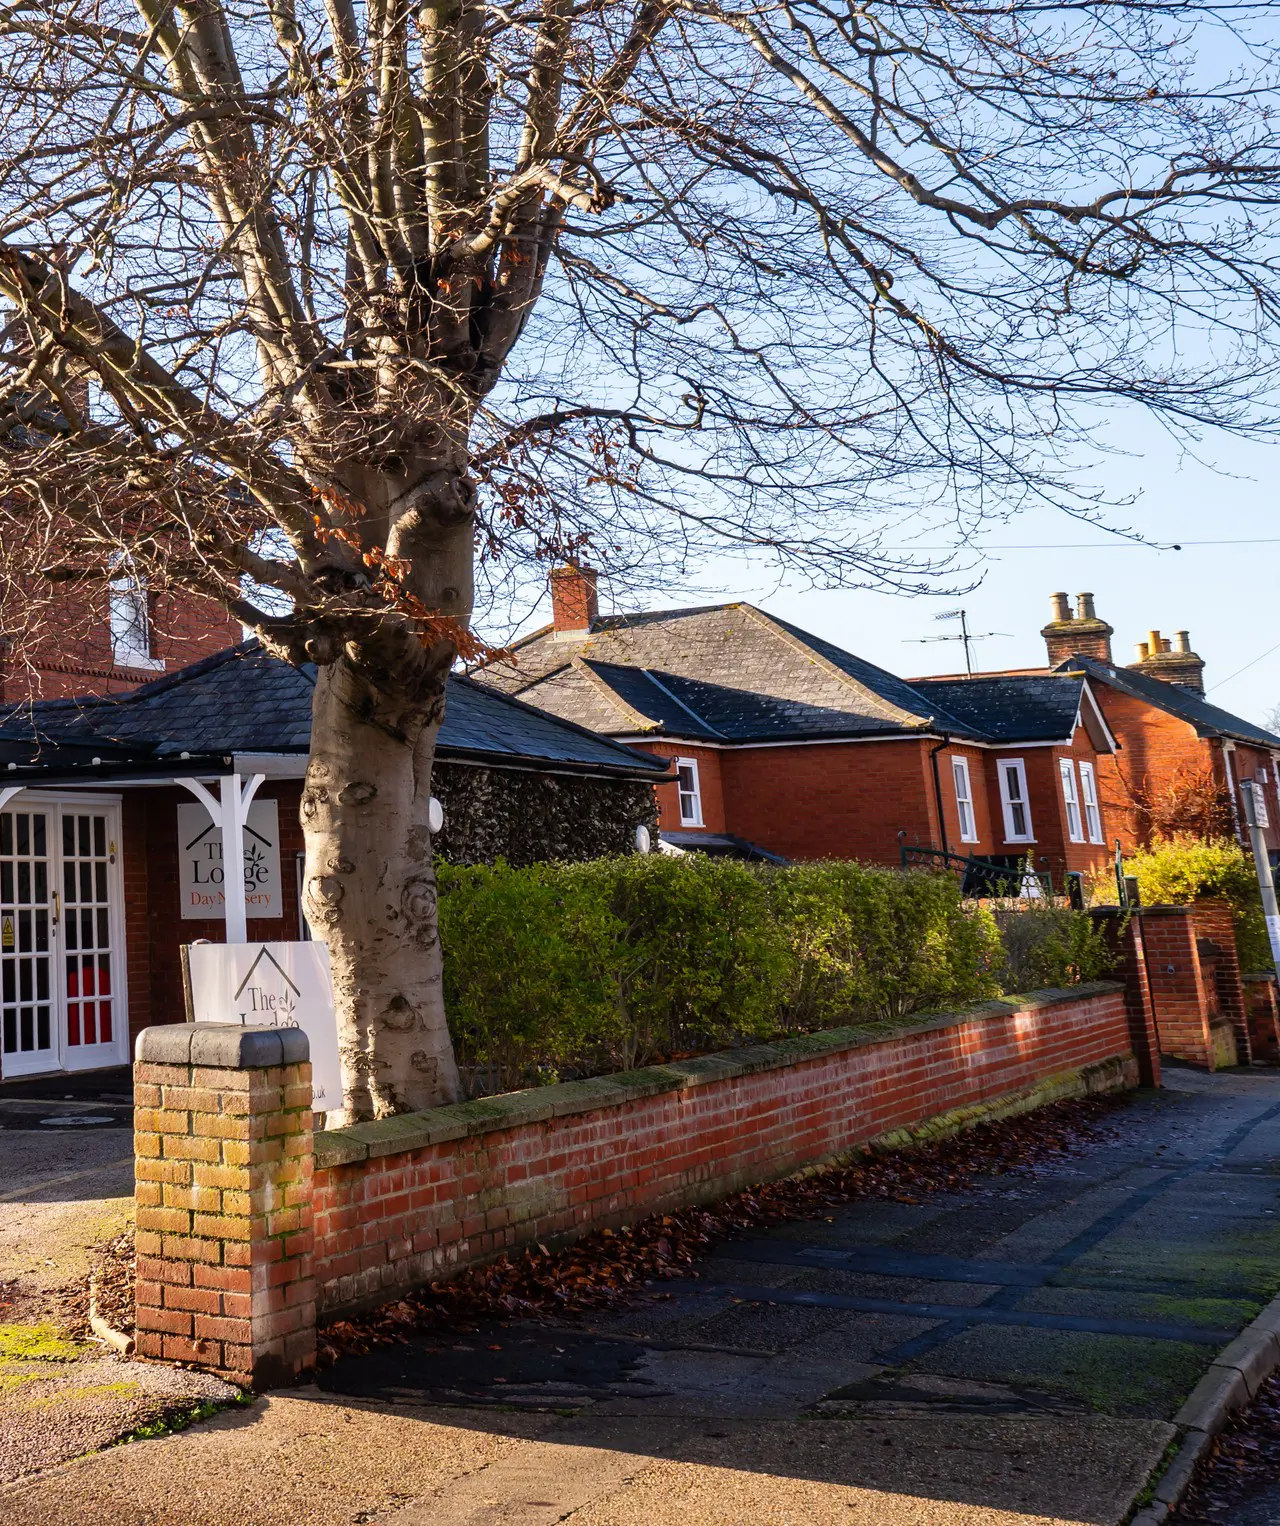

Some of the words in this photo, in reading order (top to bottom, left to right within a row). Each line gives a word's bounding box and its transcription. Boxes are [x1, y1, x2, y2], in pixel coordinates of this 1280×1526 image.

[192, 860, 269, 893] Loge
[191, 892, 216, 909] Day
[218, 892, 272, 909] Nsery
[248, 987, 276, 1012] The
